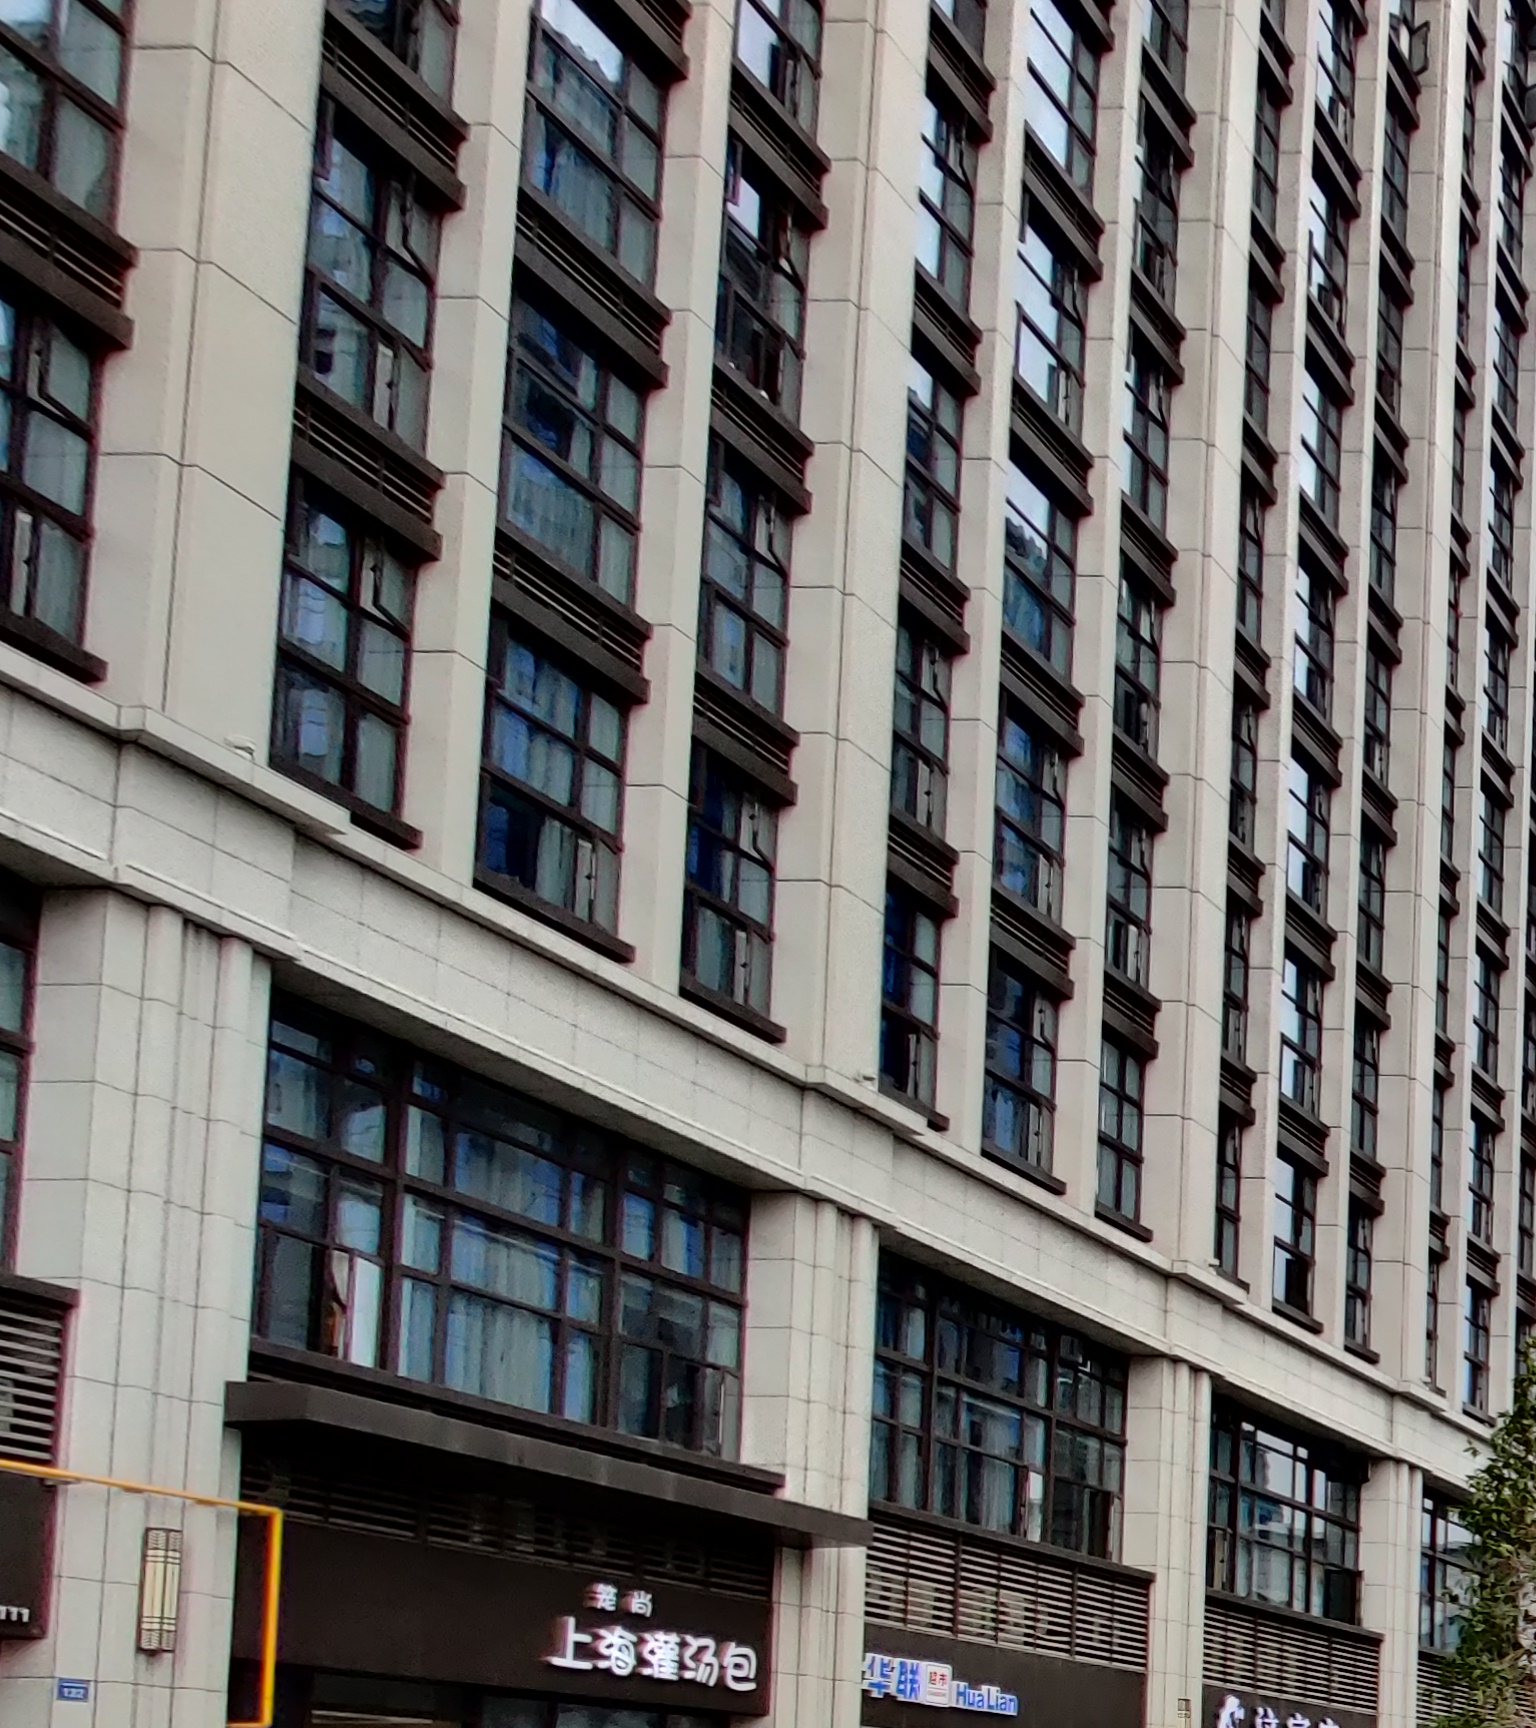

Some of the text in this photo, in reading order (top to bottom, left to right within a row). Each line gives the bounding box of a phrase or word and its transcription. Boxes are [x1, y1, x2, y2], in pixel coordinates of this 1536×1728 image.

[546, 1616, 757, 1692] 上海灌汤包
[862, 1653, 921, 1701] 华联
